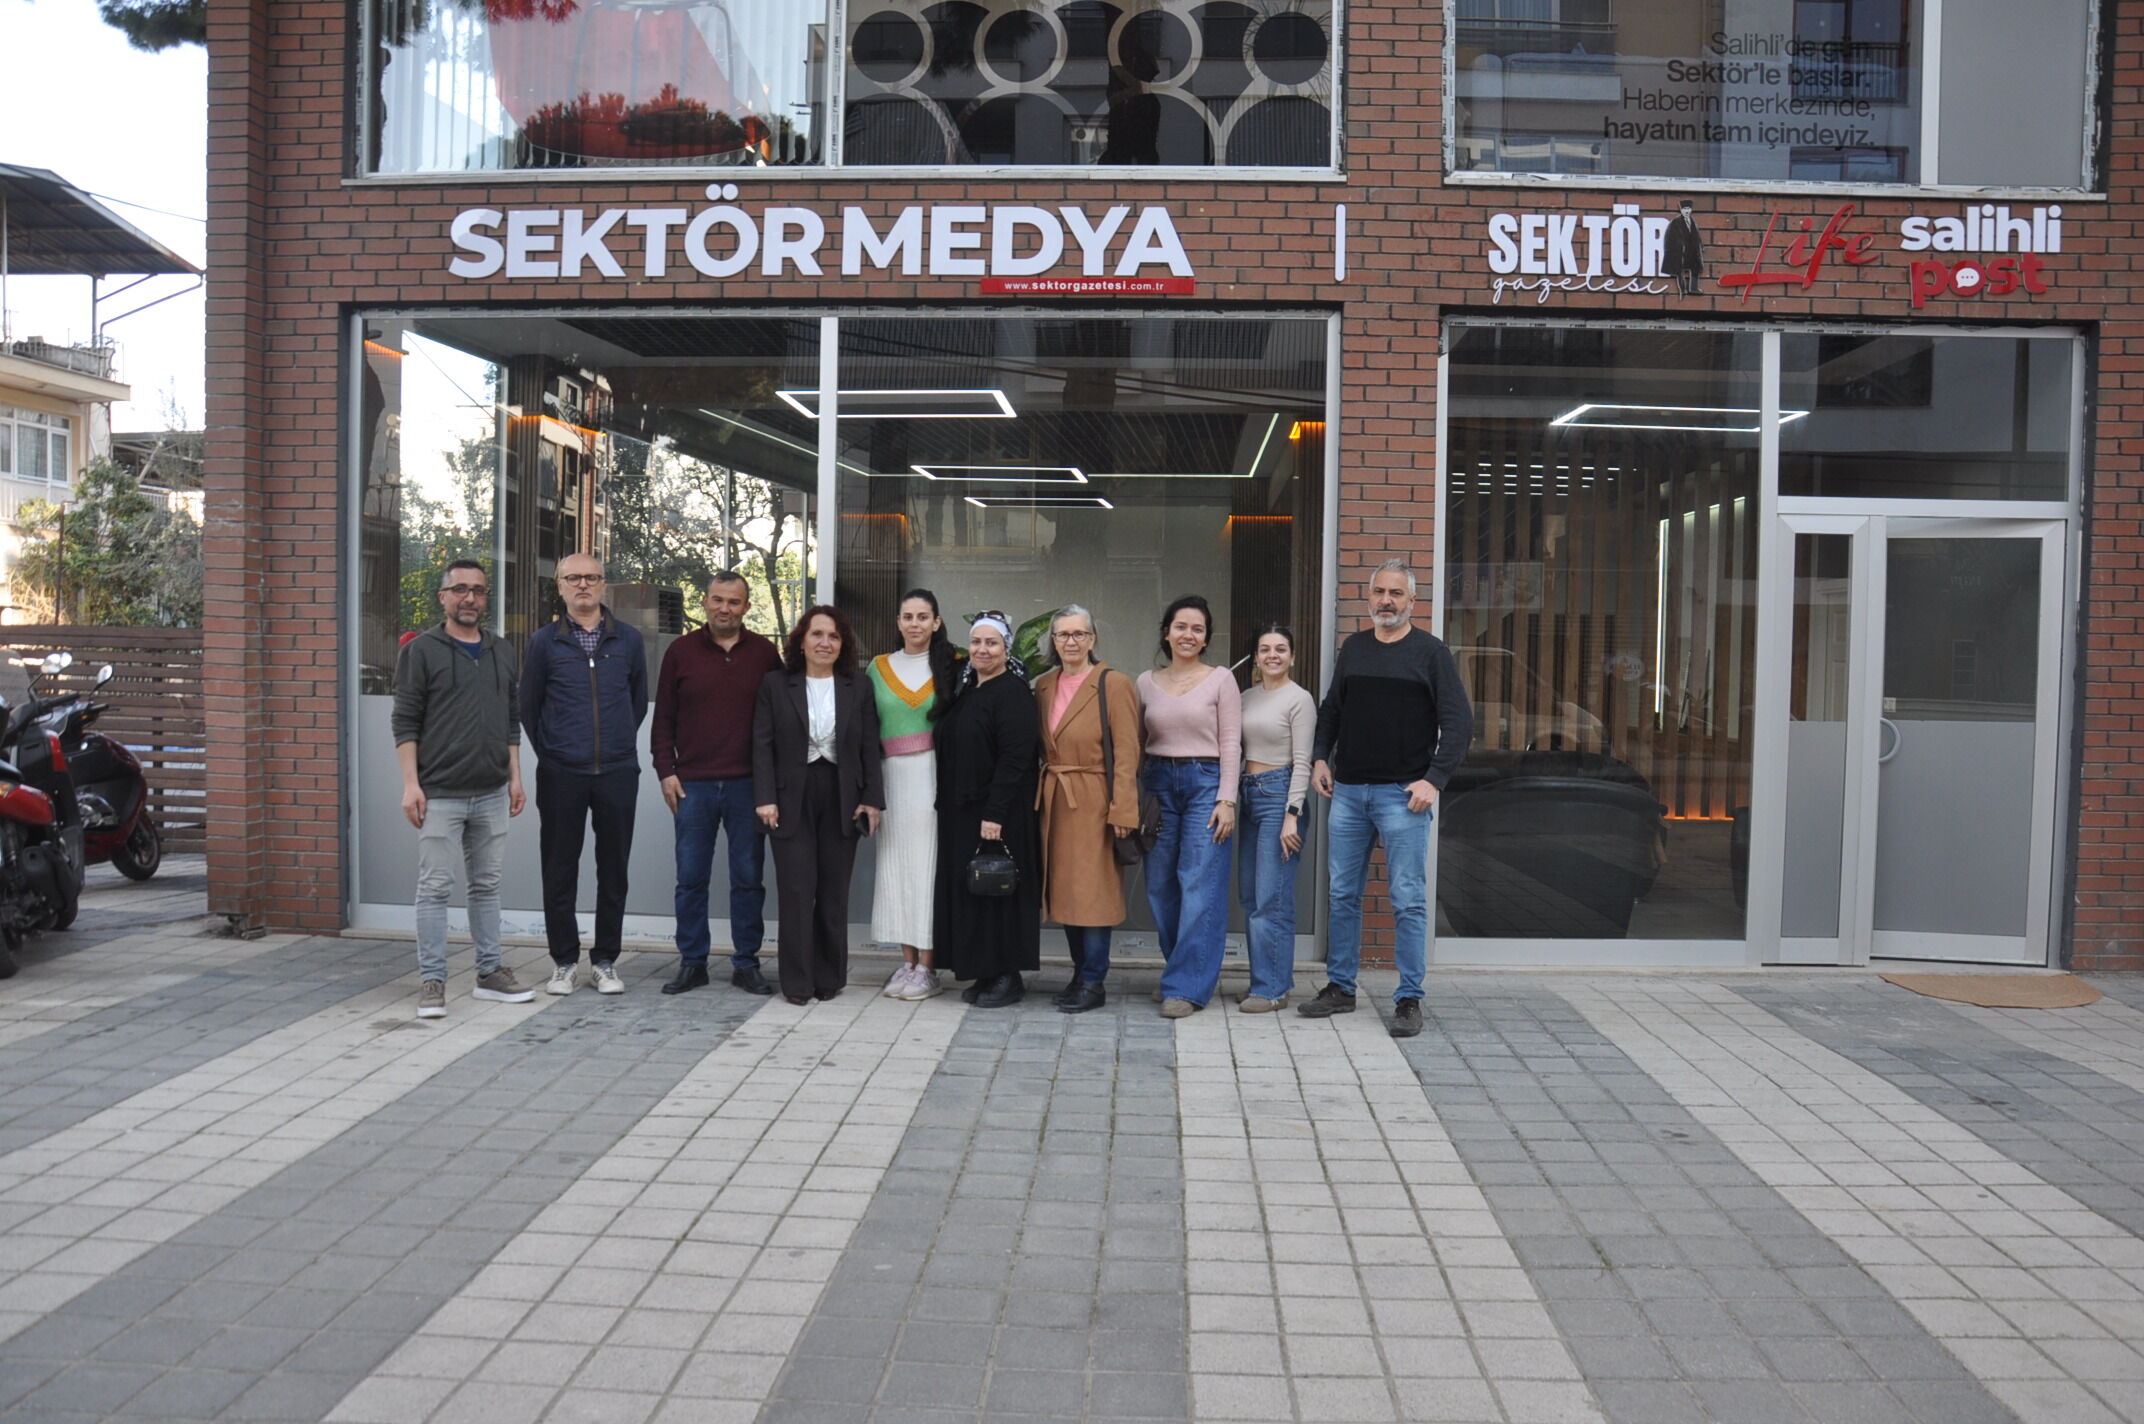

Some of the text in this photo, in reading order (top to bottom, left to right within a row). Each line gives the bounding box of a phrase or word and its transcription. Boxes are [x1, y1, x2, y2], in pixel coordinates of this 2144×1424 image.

[1623, 87, 1875, 120] Haberin merkezinde,
[1603, 116, 1875, 151] hayatın tam içindeyiz.
[449, 184, 1195, 278] SEKTÖR MEDYA
[1488, 203, 1671, 277] SEKTÖR
[1717, 203, 1880, 304] Life
[1900, 203, 2062, 253] salihli
[1004, 280, 1164, 293] www.sektorgazetesi.com.tr
[1909, 251, 2048, 308] post
